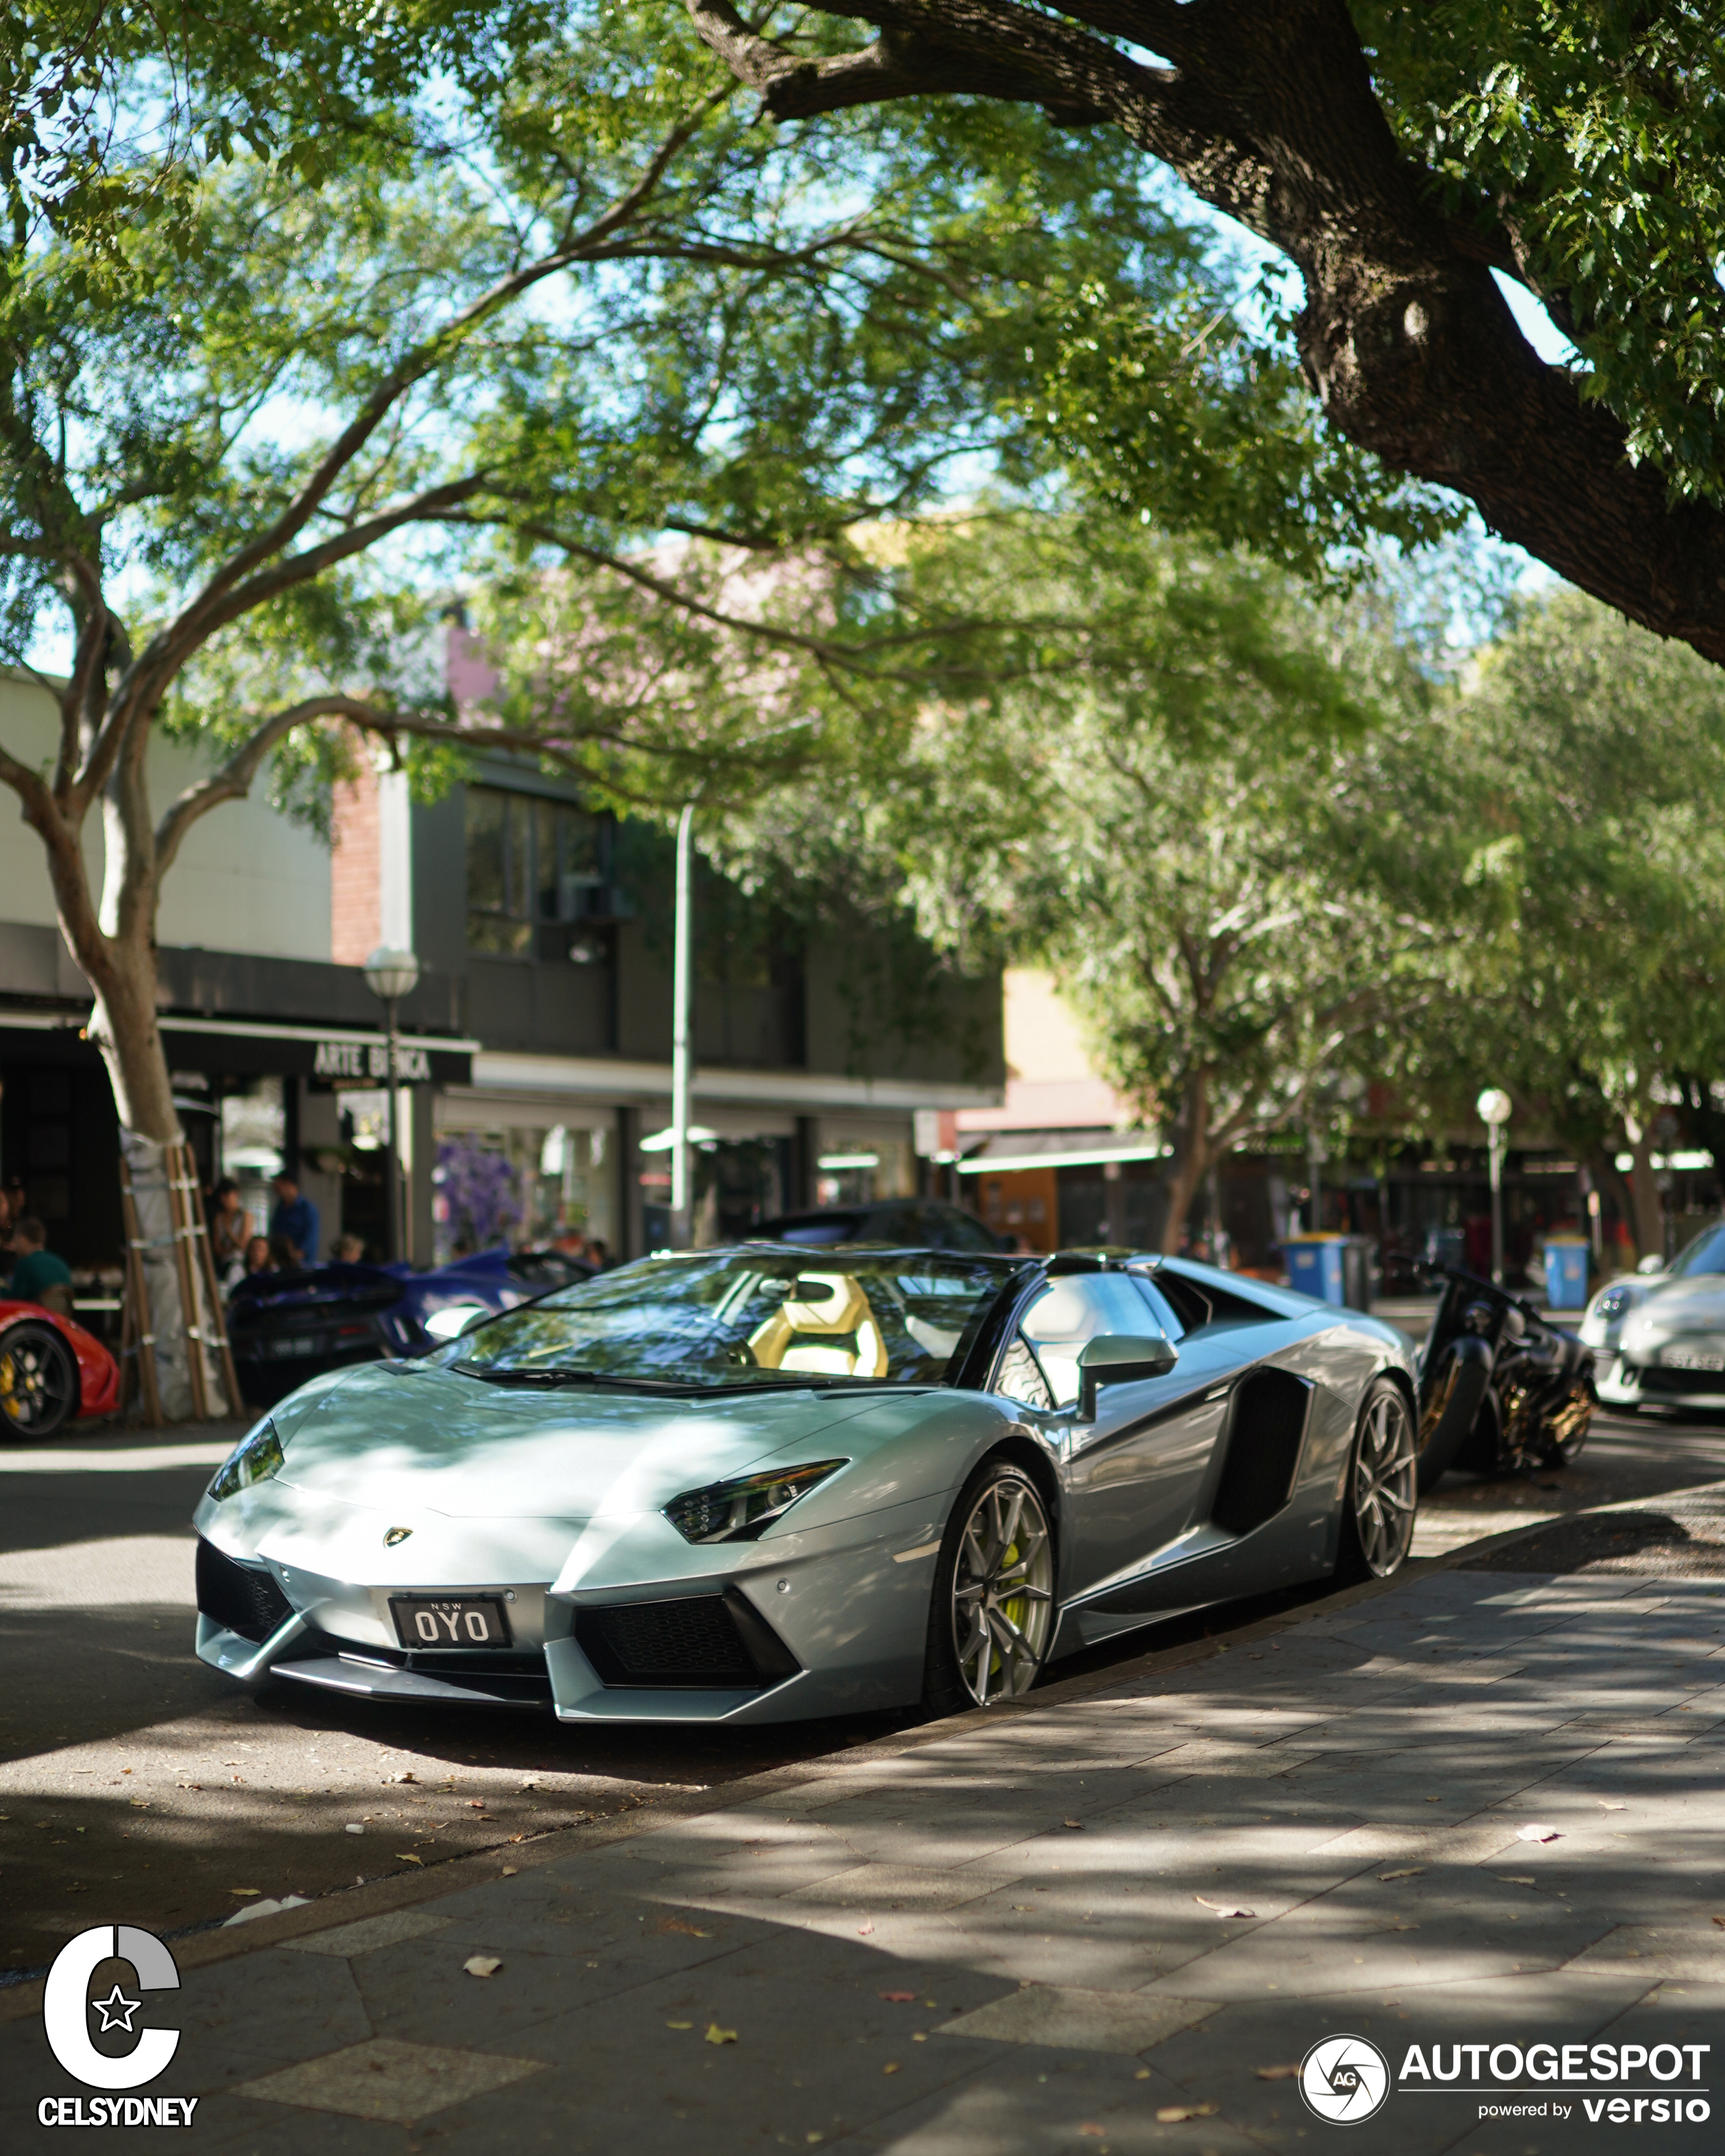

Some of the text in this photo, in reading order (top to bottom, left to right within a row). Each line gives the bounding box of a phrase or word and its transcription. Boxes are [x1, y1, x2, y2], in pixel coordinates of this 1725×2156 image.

[314, 1042, 431, 1080] ARTE BINCA
[431, 1603, 461, 1611] NSW
